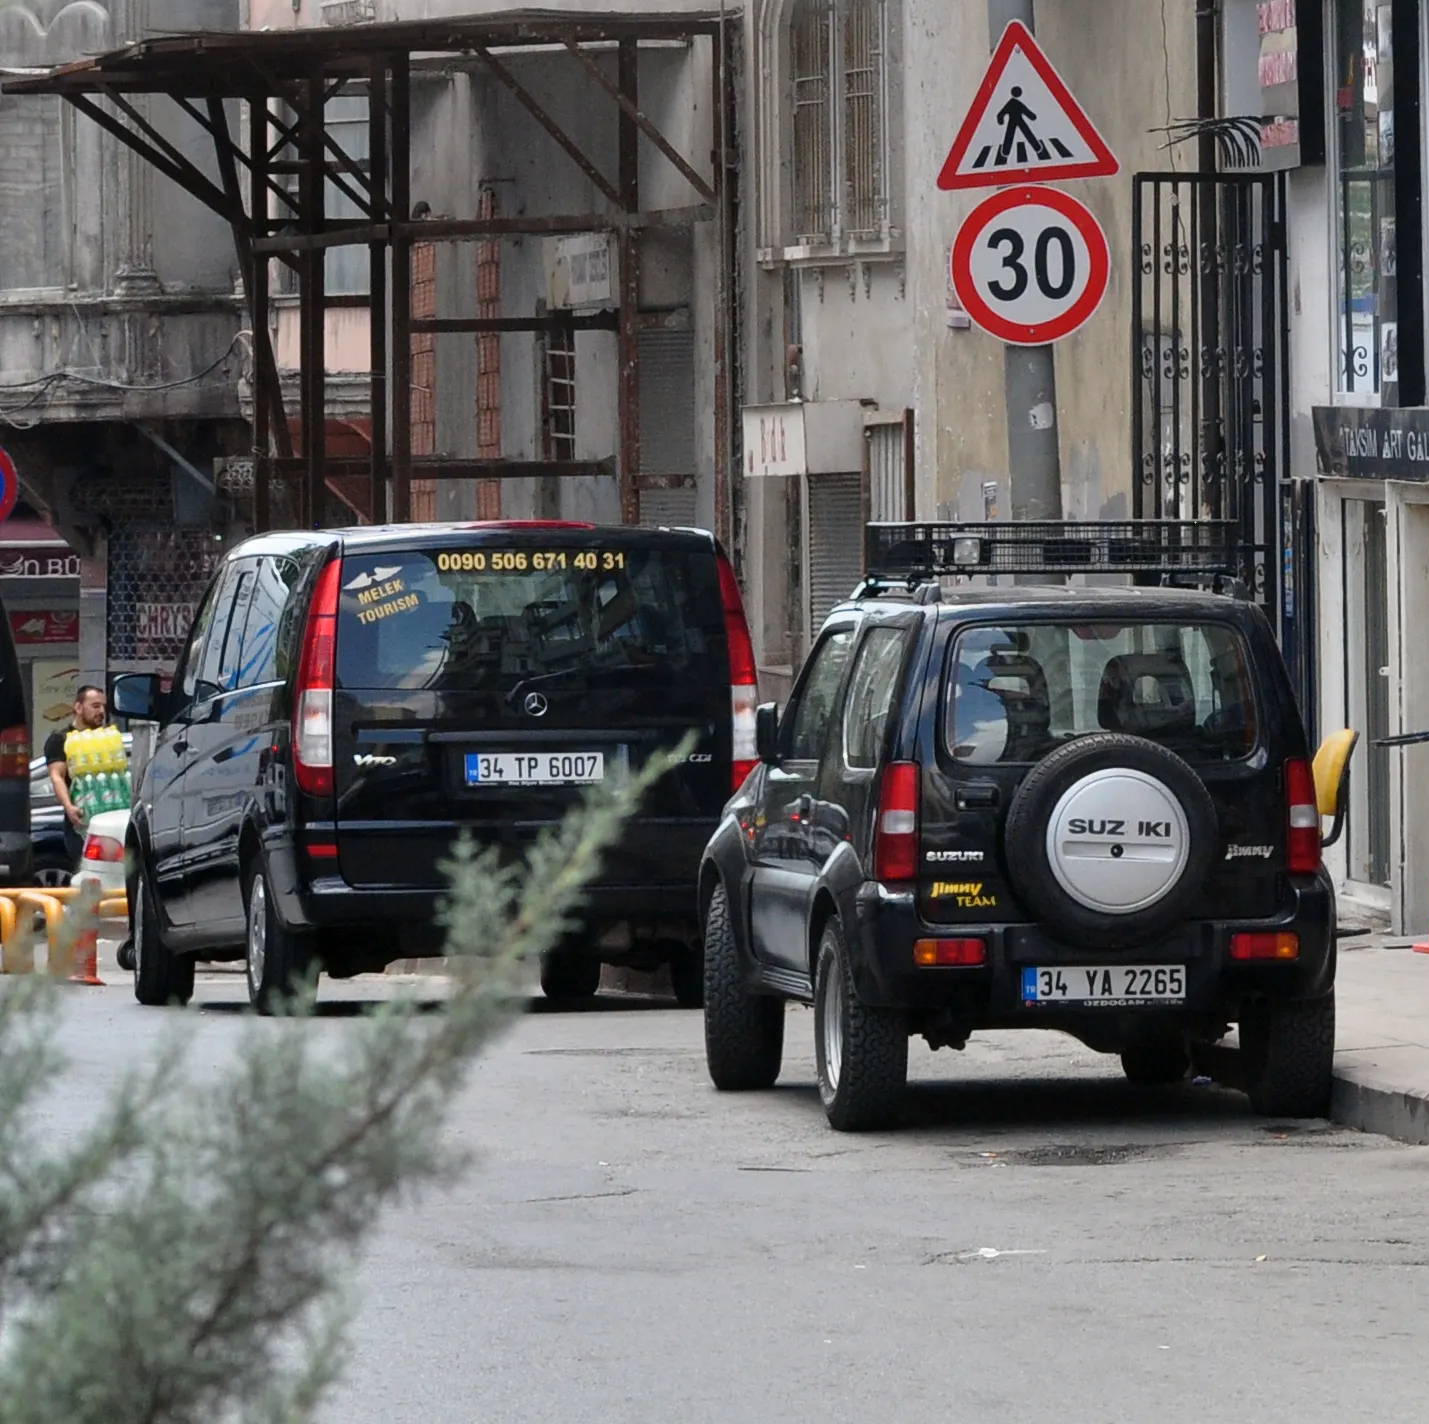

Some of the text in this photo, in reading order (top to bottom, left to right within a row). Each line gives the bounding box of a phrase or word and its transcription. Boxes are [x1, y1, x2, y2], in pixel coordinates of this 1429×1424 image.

[986, 226, 1076, 303] 30
[1382, 428, 1403, 459] ART
[438, 552, 625, 571] 0090 506 671 40 31
[357, 579, 406, 606] MELEK
[356, 593, 420, 625] TOURISM
[480, 757, 504, 779] 34
[514, 756, 540, 778] TP
[549, 756, 599, 778] 6007
[925, 850, 985, 862] SUZUKI
[929, 881, 983, 898] Jimny
[957, 895, 997, 908] TEAM
[1039, 970, 1068, 997] 34
[1085, 969, 1114, 996] YA
[1124, 968, 1184, 996] 2265
